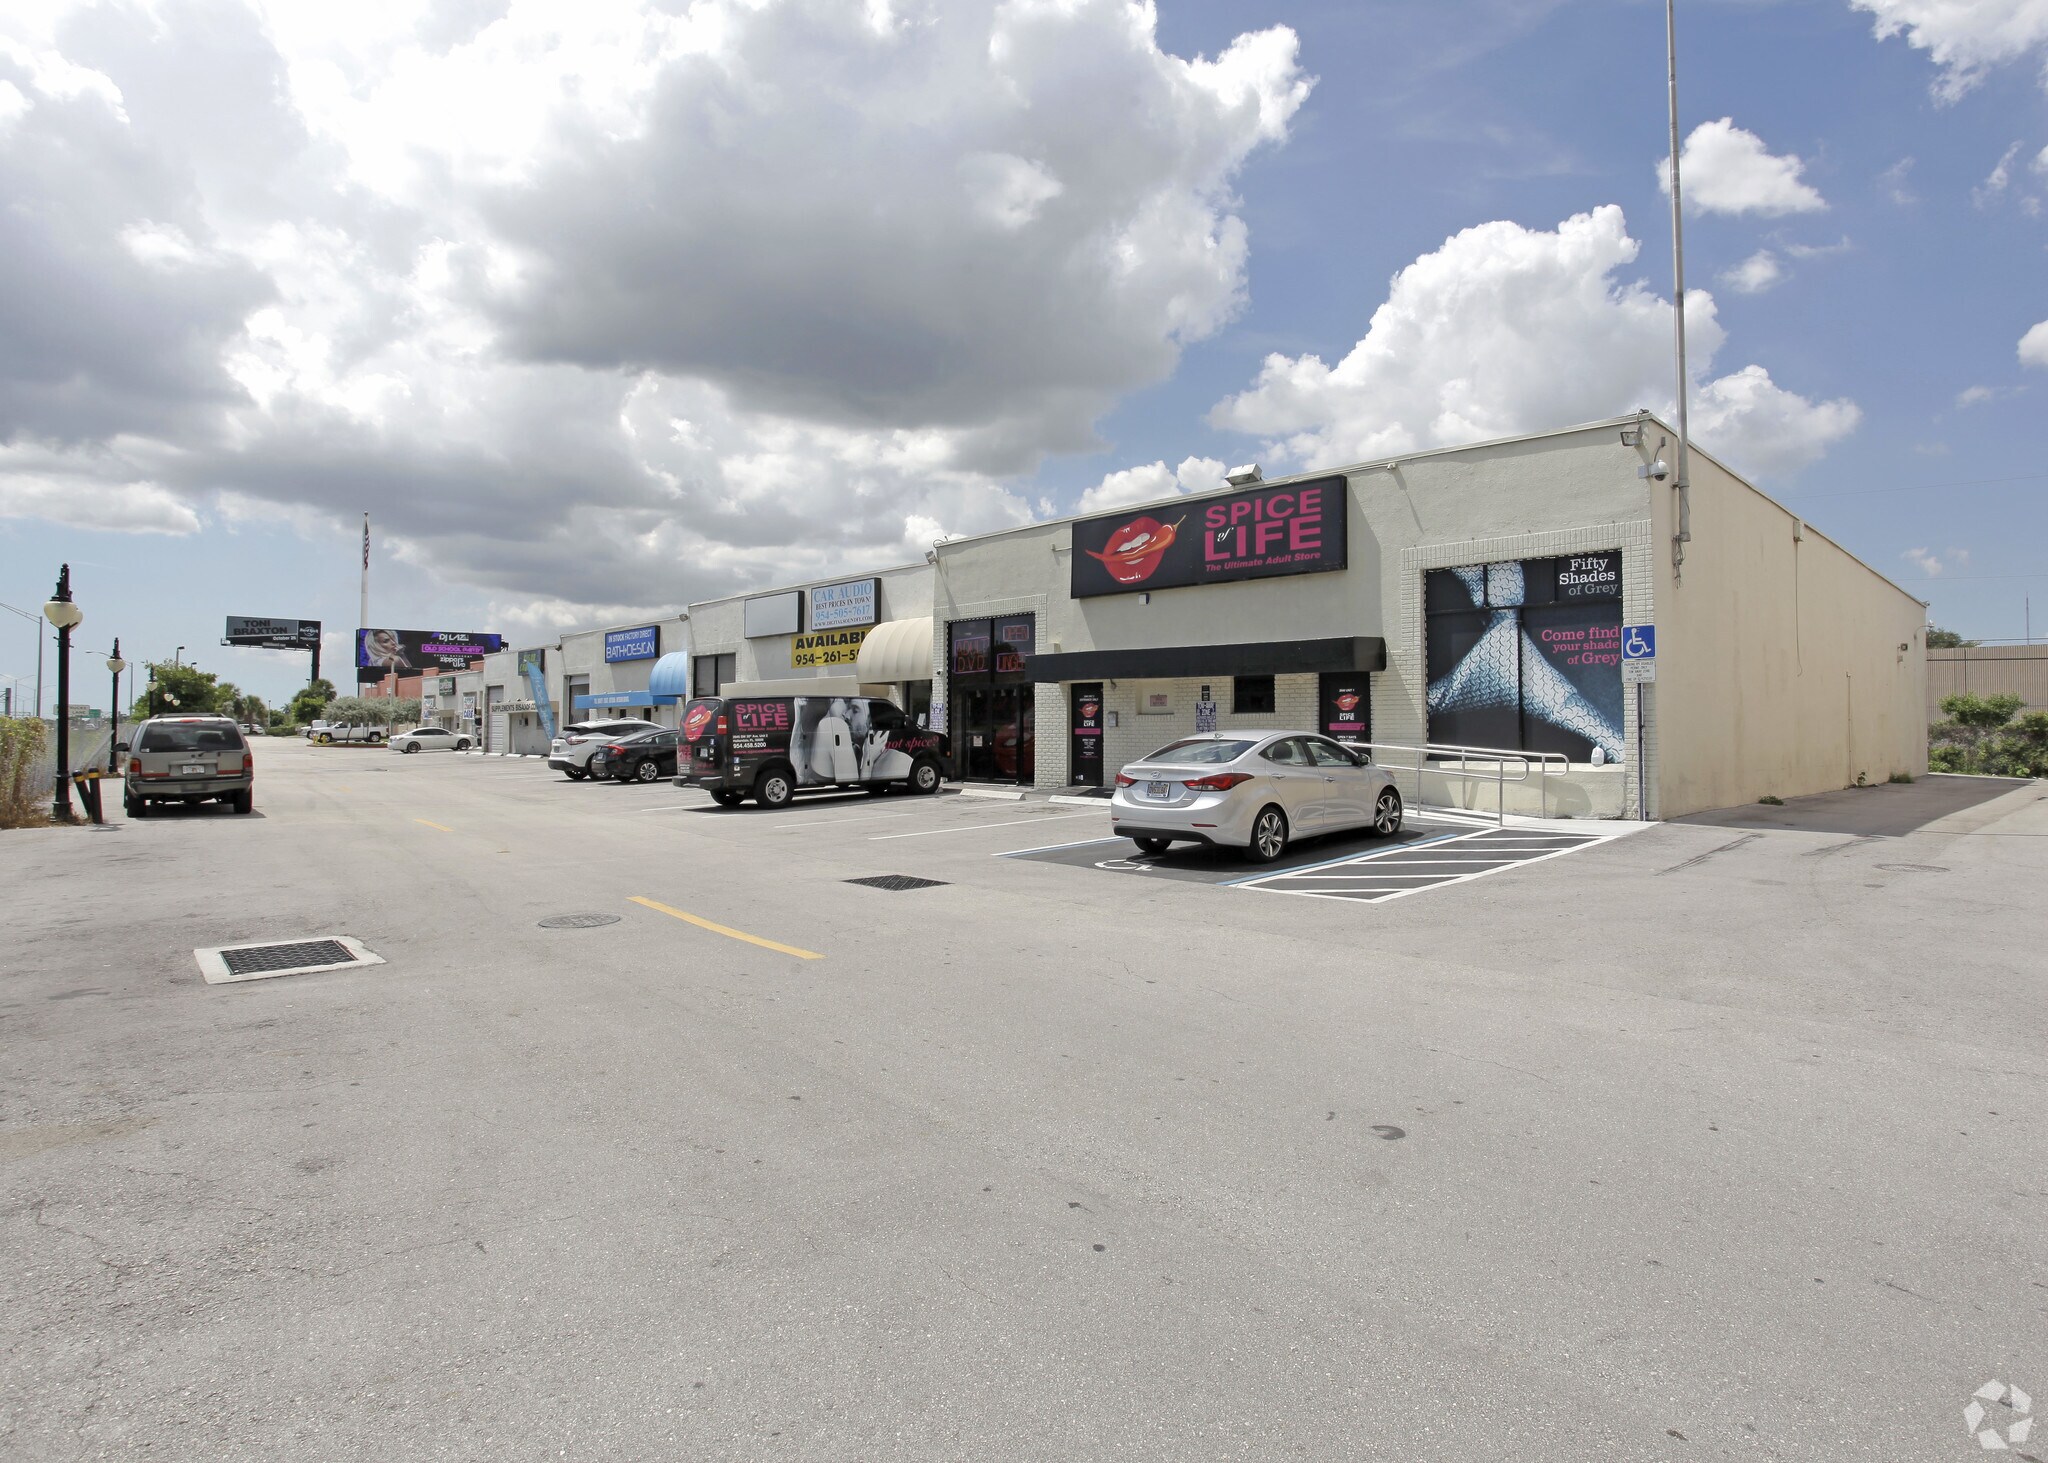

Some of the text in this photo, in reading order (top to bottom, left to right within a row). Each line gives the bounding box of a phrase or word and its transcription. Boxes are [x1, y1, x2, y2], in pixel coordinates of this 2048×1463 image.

[1205, 489, 1322, 528] SPICE
[1205, 514, 1322, 561] LIFE
[1217, 527, 1234, 542] of
[1224, 558, 1262, 570] Ultimate
[1266, 554, 1292, 565] Adult
[1294, 552, 1320, 562] Store
[1570, 558, 1608, 571] Fifty
[1560, 570, 1616, 585] Shades
[814, 582, 872, 602] CAR AUDIO
[1568, 583, 1618, 596] of Grey
[828, 600, 846, 608] PRICES
[816, 604, 870, 621] 954-505-7617
[234, 626, 288, 635] BRAXTON
[613, 634, 624, 642] STOCK
[625, 631, 639, 640] FACTORY
[640, 629, 652, 638] DIRECT
[1541, 626, 1619, 641] Come find
[796, 631, 866, 649] AVAILABL
[1552, 640, 1619, 654] your shade
[1568, 652, 1620, 666] of Grey
[492, 704, 515, 712] SUPPLEMENTS
[735, 704, 786, 713] SPICE
[737, 713, 789, 727] LIFE
[905, 735, 939, 752] spice?
